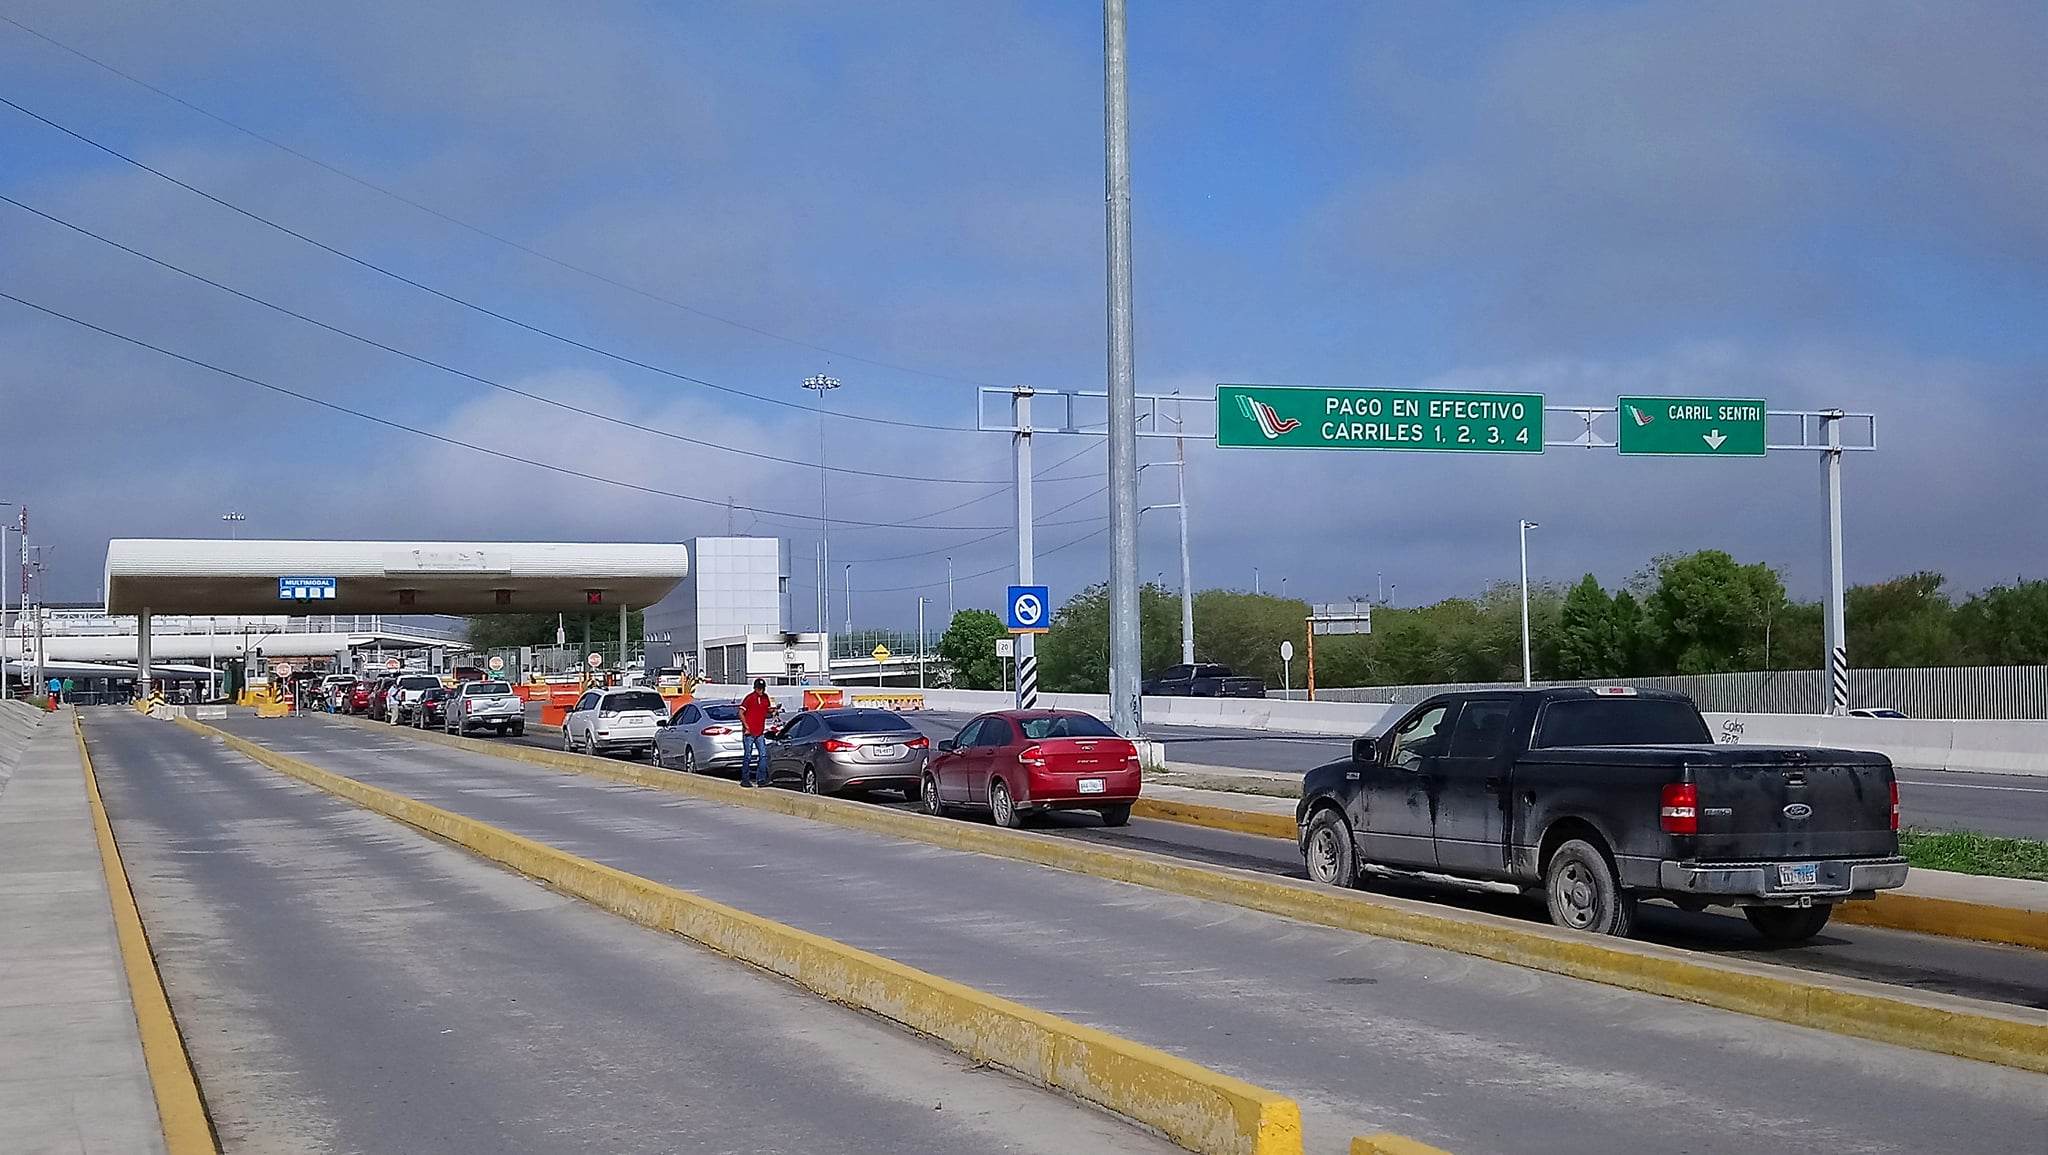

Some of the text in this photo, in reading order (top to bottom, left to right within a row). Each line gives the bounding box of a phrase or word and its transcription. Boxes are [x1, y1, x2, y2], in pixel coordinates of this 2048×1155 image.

[1326, 398, 1524, 420] PAGO EN EFECTIVO
[1668, 405, 1760, 421] CARRIL SENTRI
[1321, 422, 1423, 441] CARRILES
[1516, 428, 1529, 444] 4
